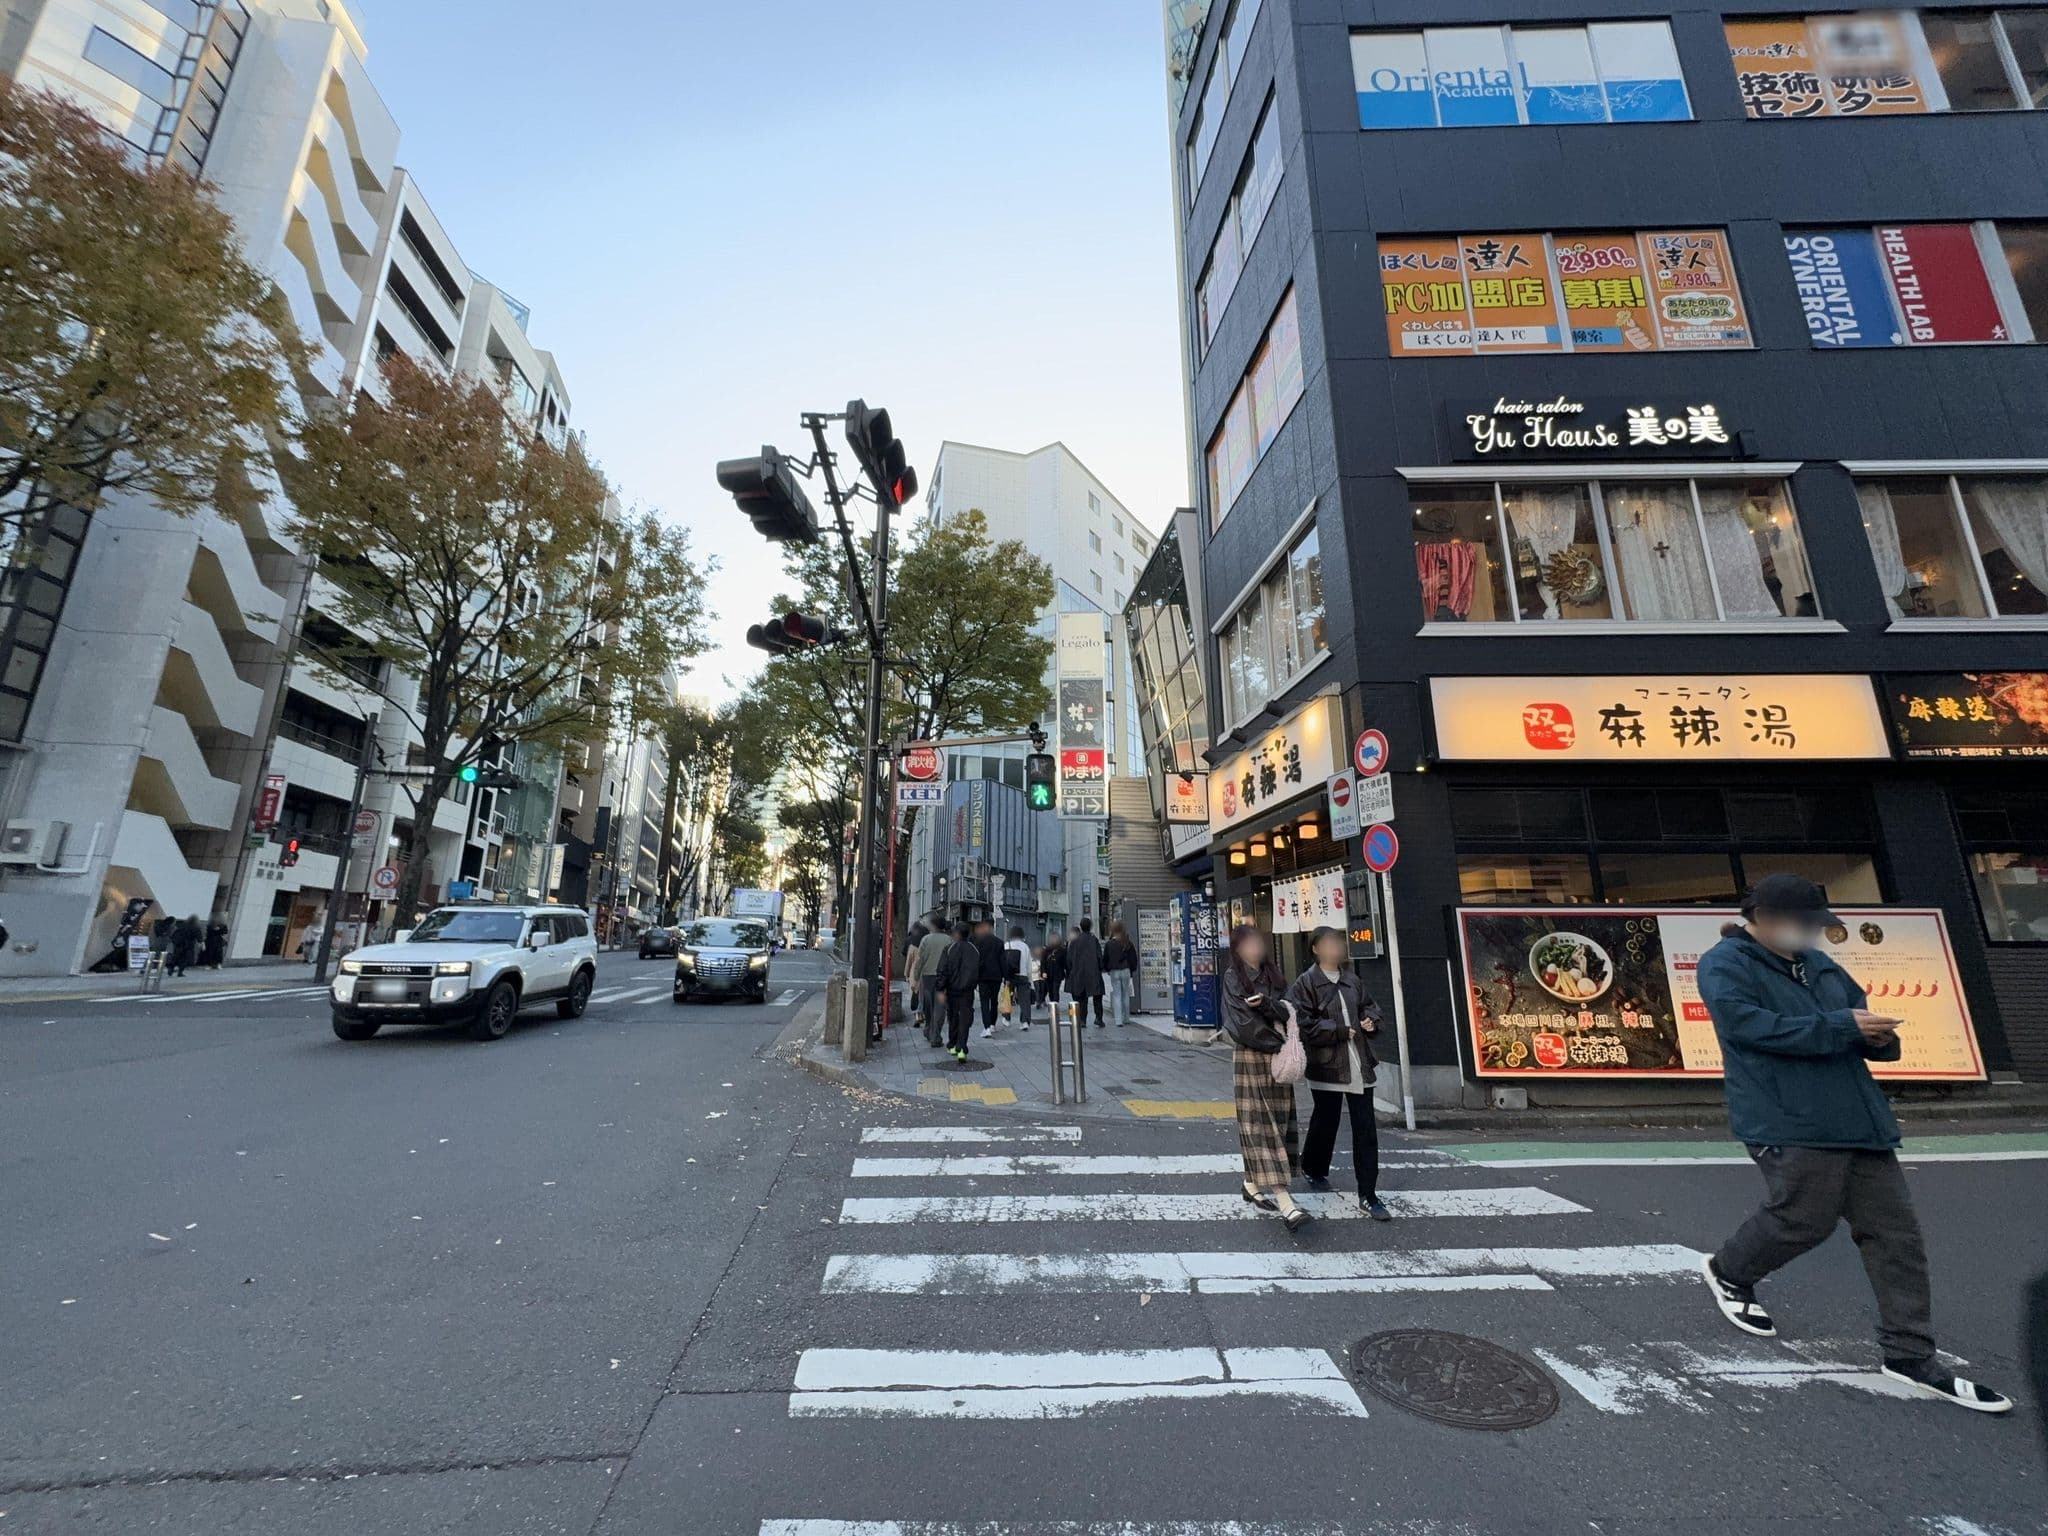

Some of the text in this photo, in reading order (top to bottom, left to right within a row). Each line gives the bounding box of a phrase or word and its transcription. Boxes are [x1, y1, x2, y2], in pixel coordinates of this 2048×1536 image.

[1371, 62, 1528, 92] Oriental
[1436, 83, 1533, 102] Academy
[1746, 90, 1917, 117] センター
[1381, 240, 1530, 271] ほぐしの達人
[1383, 277, 1546, 314] FC加盟店
[1784, 237, 1836, 345] SYNERGY
[1810, 236, 1861, 345] ORIENTAL
[1881, 228, 1935, 341] HEALTH LAB
[1417, 330, 1505, 345] ほぐしの達人
[1511, 329, 1527, 341] FC
[1494, 396, 1584, 414] hair salon
[1627, 405, 1729, 445] 美の美
[1061, 639, 1101, 648] Legato
[1634, 686, 1751, 700] マーラータン
[1598, 704, 1796, 750] 麻辣湯
[907, 756, 935, 768] 消火栓
[1064, 766, 1102, 779] やまや
[1241, 743, 1302, 808] 麻辣湯
[903, 789, 938, 799] KEN
